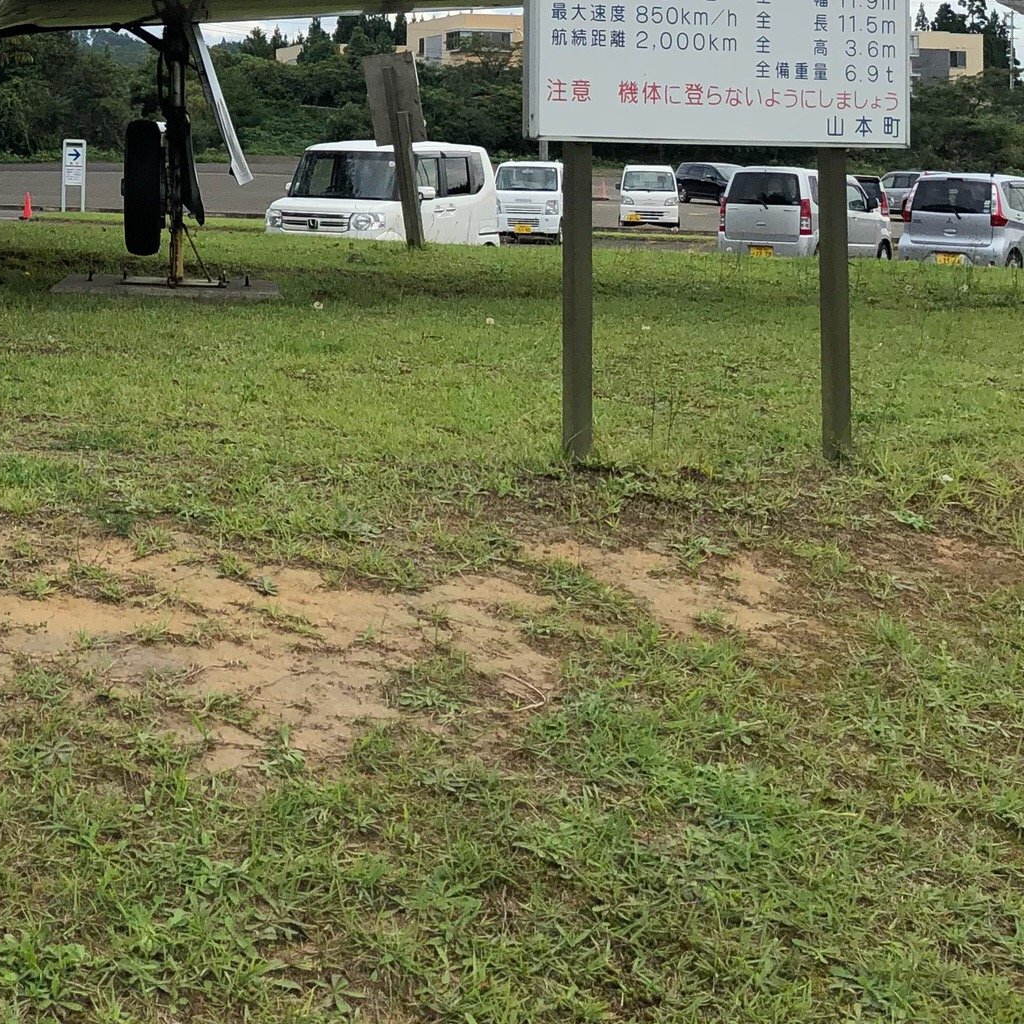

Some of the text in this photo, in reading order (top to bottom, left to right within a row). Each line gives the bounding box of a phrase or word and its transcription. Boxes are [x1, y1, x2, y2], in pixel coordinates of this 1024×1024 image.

[551, 2, 737, 27] 最大速度 850km/h
[838, 14, 896, 35] 11.5m
[551, 28, 738, 52] 航続距離 2,000km
[844, 39, 896, 59] 3.6m
[755, 60, 828, 81] 全備重量
[546, 79, 899, 112] 注意 機体に登らないようにしましょう
[827, 115, 901, 138] 山本町
